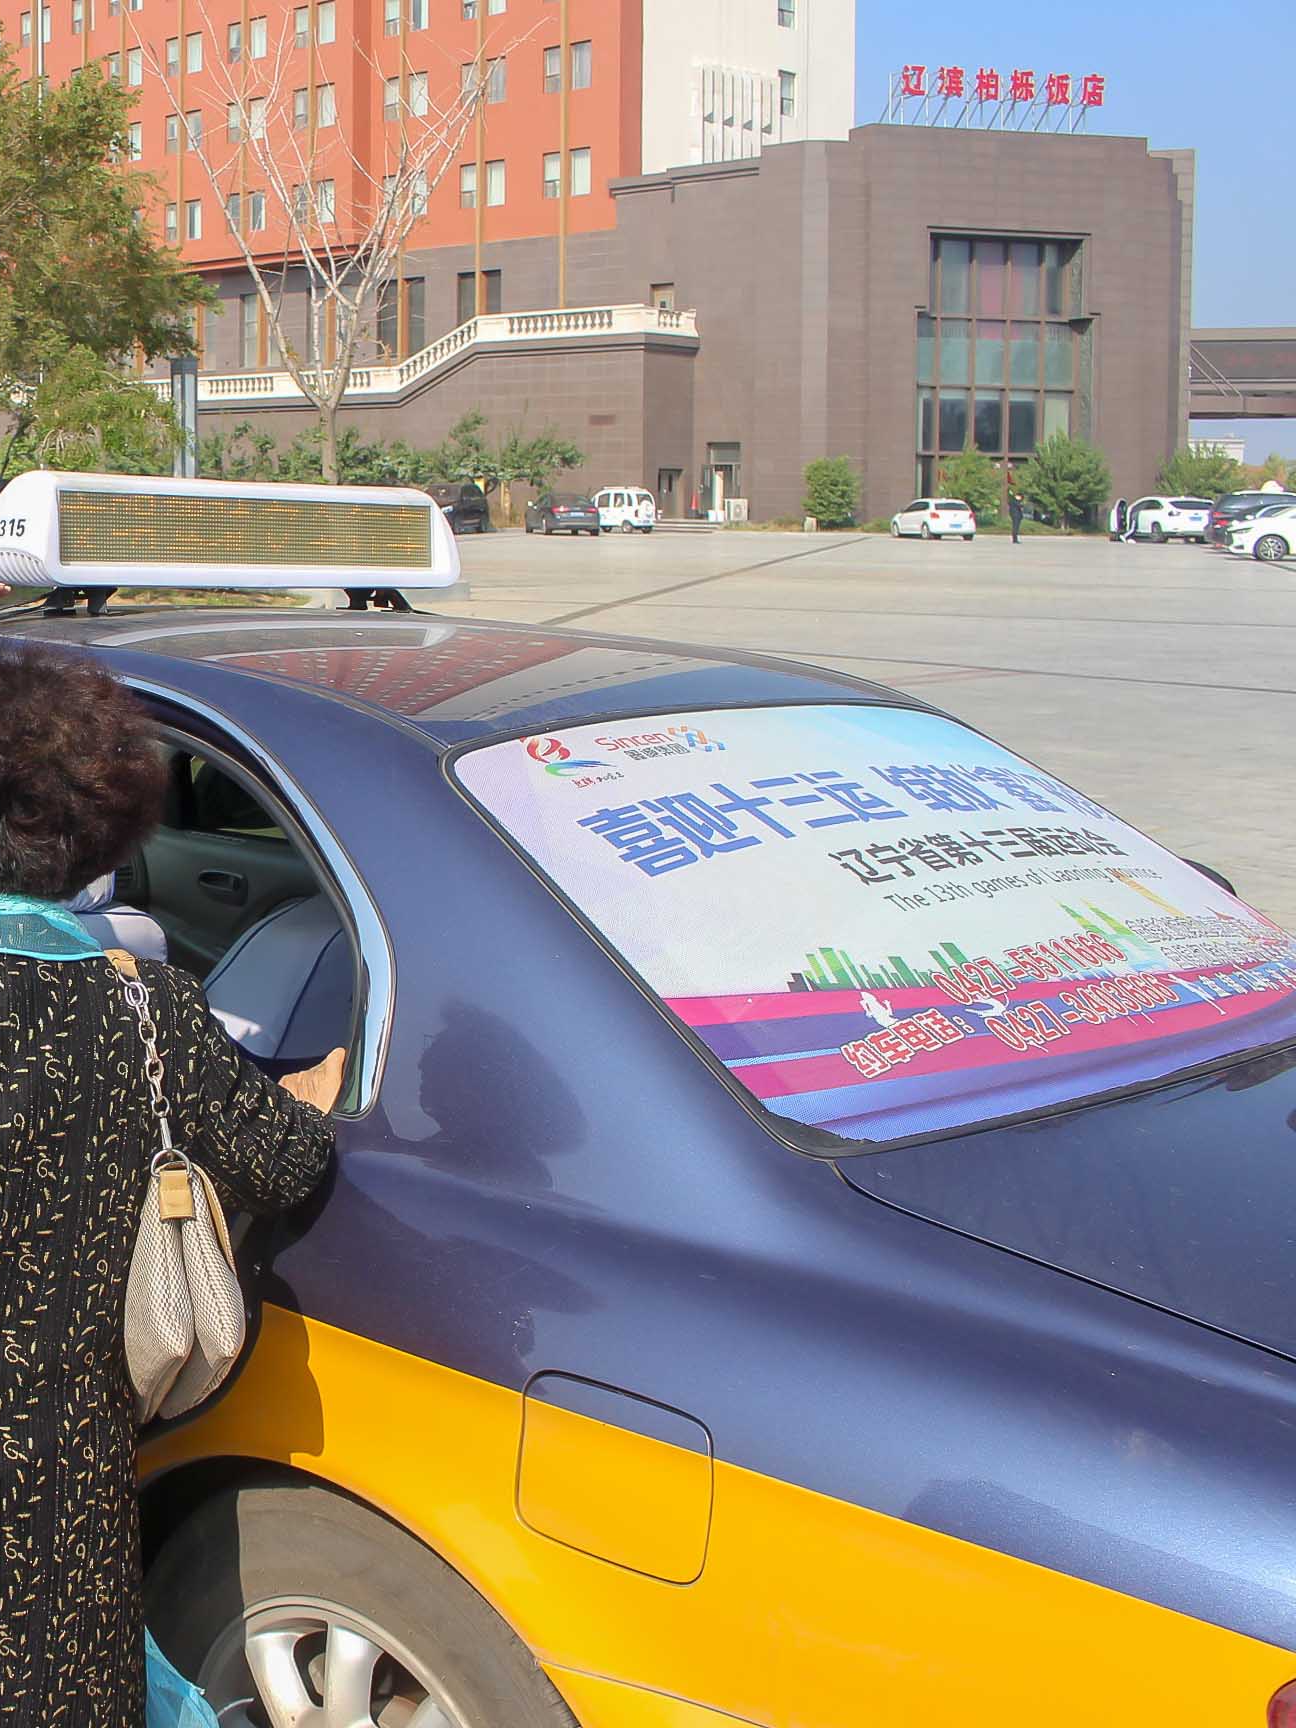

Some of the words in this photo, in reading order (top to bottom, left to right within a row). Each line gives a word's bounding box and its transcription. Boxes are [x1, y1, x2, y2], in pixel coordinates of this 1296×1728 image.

[594, 732, 673, 752] Sincen
[576, 770, 908, 877] 喜迎十三运
[828, 826, 1129, 886] 辽宁省第十三届运动会
[883, 892, 931, 912] The
[923, 881, 975, 902] 13th
[971, 874, 1028, 898] games
[1025, 867, 1048, 886] of
[1038, 865, 1114, 883] Liaoning
[930, 931, 1128, 1005] 0427-5511666
[984, 972, 1181, 1051] 0427-3403666
